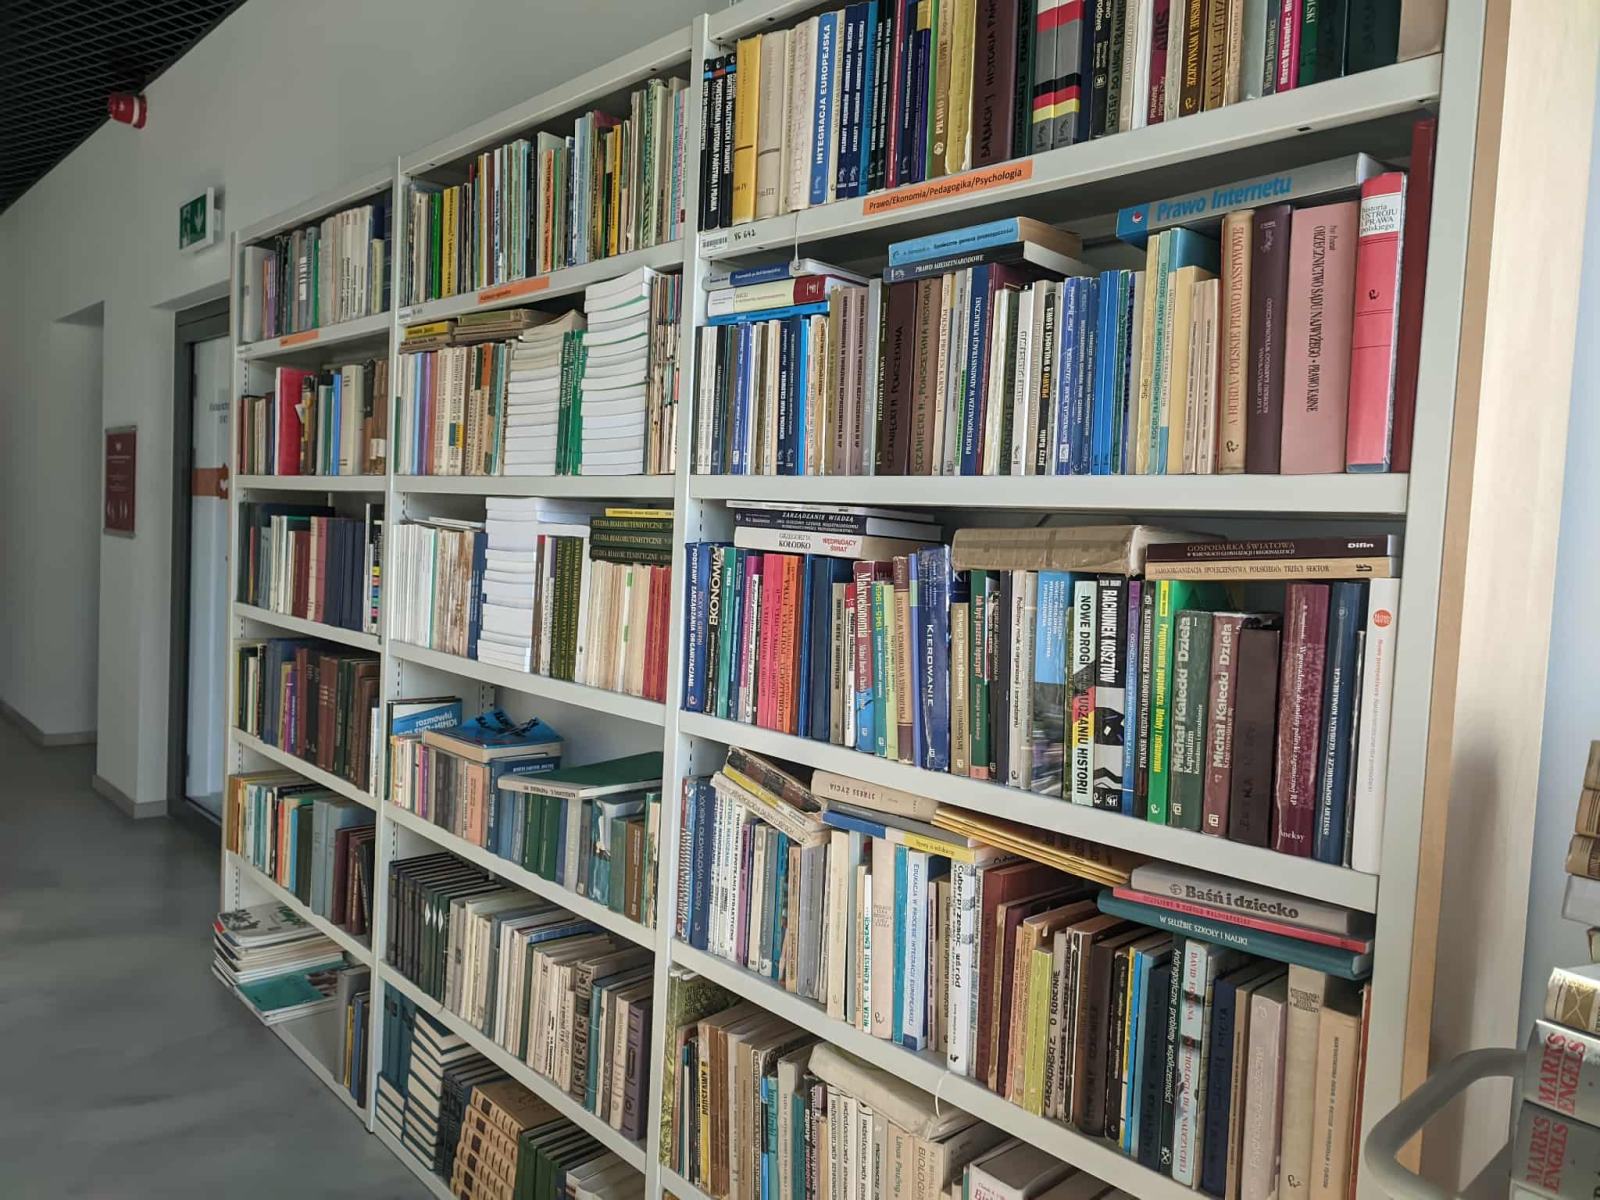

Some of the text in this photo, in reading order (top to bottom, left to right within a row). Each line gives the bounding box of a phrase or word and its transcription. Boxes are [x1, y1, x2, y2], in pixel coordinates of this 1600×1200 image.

[1210, 43, 1225, 103] PRAWA
[1279, 58, 1289, 85] Marek
[713, 79, 723, 122] POWSZECHNA
[816, 24, 831, 164] INTEGRACJA EUROPEJSKA
[712, 123, 721, 153] HISTORIA
[711, 154, 721, 183] PAŃSTWA
[868, 167, 1023, 212] Prawo/Ekonomia/Pedagogika/Psychologia
[710, 188, 718, 212] PRAWA
[1155, 175, 1293, 222] Prawo Internetu
[1361, 204, 1387, 213] historia
[1361, 207, 1398, 221] USTROJU
[1365, 215, 1394, 226] PRAWA
[1360, 224, 1395, 235] polskiego
[1311, 225, 1326, 288] ORZECZNICTWO
[1045, 306, 1054, 330] SŁOWA
[1229, 226, 1245, 415] BURDA POLSKIE PRAWO PAŃSTWOWE
[1308, 288, 1324, 311] SĄDU
[918, 327, 930, 396] POWSZECHNA
[936, 308, 949, 396] POLSKI PROCES KARNY
[1042, 331, 1054, 366] WOLNOŚCI
[965, 296, 982, 455] PROFESJONALIZM W ADMINISTRACJI PUBLICZNEJ
[1041, 373, 1050, 399] PRAWO
[1307, 364, 1320, 388] PRAWO
[877, 383, 885, 421] FILOZOFIA
[1305, 388, 1320, 412] KARNE
[1037, 448, 1047, 466] Jerzy
[782, 511, 825, 521] ZARZĄDZANIE
[690, 548, 698, 585] PODSTAWY
[778, 540, 811, 550] KOŁODKO
[1187, 541, 1296, 552] GOSPODARKA ŚWIATOWA
[1284, 564, 1330, 573] TRZECI SEKTOR
[689, 585, 697, 631] ZARZĄDZANIA
[856, 572, 872, 638] Makroekonomia
[875, 584, 883, 632] 1945-1969
[1013, 596, 1023, 628] Podstawy
[974, 595, 984, 678] Jak być jeszcze lepszym?
[1098, 589, 1118, 683] RACHUNEK KOSZTÓW
[1157, 623, 1169, 669] Prognozowanie
[926, 624, 935, 707] KIEROWANIE
[1076, 595, 1091, 794] NOWE DROGI HISTORII
[1139, 608, 1152, 769] FINANSE MIĘDZYNARODOWE PRZEDSIĘBIORSTW
[1173, 616, 1191, 772] Michał Kalecki Dzieła
[1212, 623, 1233, 768] Michał Kalecki Dzieła
[1331, 667, 1341, 715] KONKURENCJA
[1153, 707, 1166, 729] Metody
[1288, 646, 1307, 806] Wprowadzenie do analizy polityki zagranicznej RP
[1328, 716, 1337, 751] GLOBALNA
[1184, 730, 1194, 774] Kapitalizm
[829, 783, 875, 800] STRESS ŻYCIA
[1325, 757, 1335, 806] GOSPODARCZE
[1323, 806, 1332, 836] SYSTEMY
[695, 794, 707, 911] Historia wychowania XX
[912, 863, 920, 897] EDUKACJA
[1184, 883, 1223, 905] Baśń
[1225, 892, 1232, 906] i
[1233, 895, 1300, 920] dziecko
[910, 906, 918, 939] PROCESIE
[953, 864, 965, 989] Cyberprzemoc wśród
[1159, 915, 1167, 924] W
[1167, 916, 1193, 931] SŁUŻBIE
[1193, 923, 1219, 938] SZKOŁY
[1224, 931, 1248, 946] NAUKI
[1164, 949, 1182, 1104] Andragogiczne problemy współczesności
[1178, 952, 1197, 1174] DAVID DLA NAUCZYCIELI
[1538, 1032, 1566, 1107] MARKS
[1557, 1040, 1587, 1116] ENGELS
[893, 1135, 903, 1193] Linus Pauling
[1526, 1115, 1551, 1186] MARKS
[1543, 1120, 1569, 1195] ENGELS
